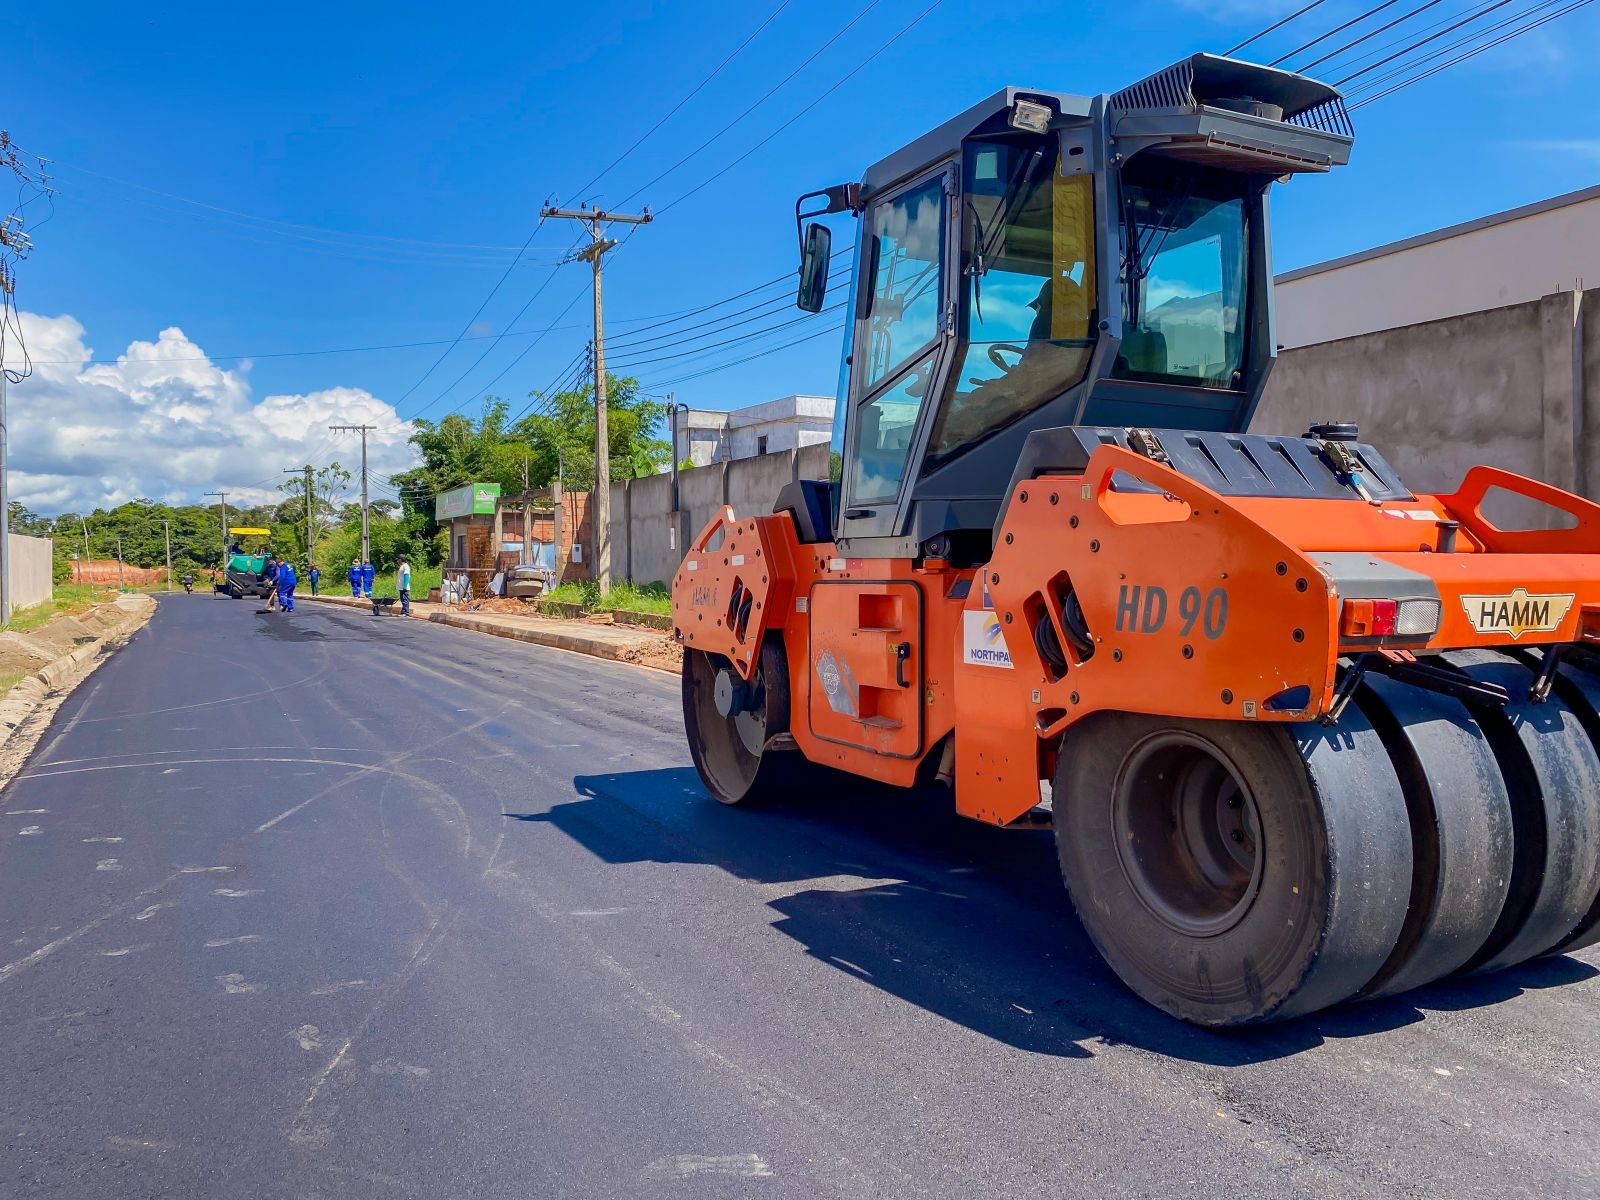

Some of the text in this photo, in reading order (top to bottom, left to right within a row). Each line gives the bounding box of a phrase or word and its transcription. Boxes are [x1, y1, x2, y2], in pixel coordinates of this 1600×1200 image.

[1115, 584, 1228, 640] HD 90
[1480, 600, 1550, 627] HAMM
[971, 648, 1012, 663] NORTHPA
